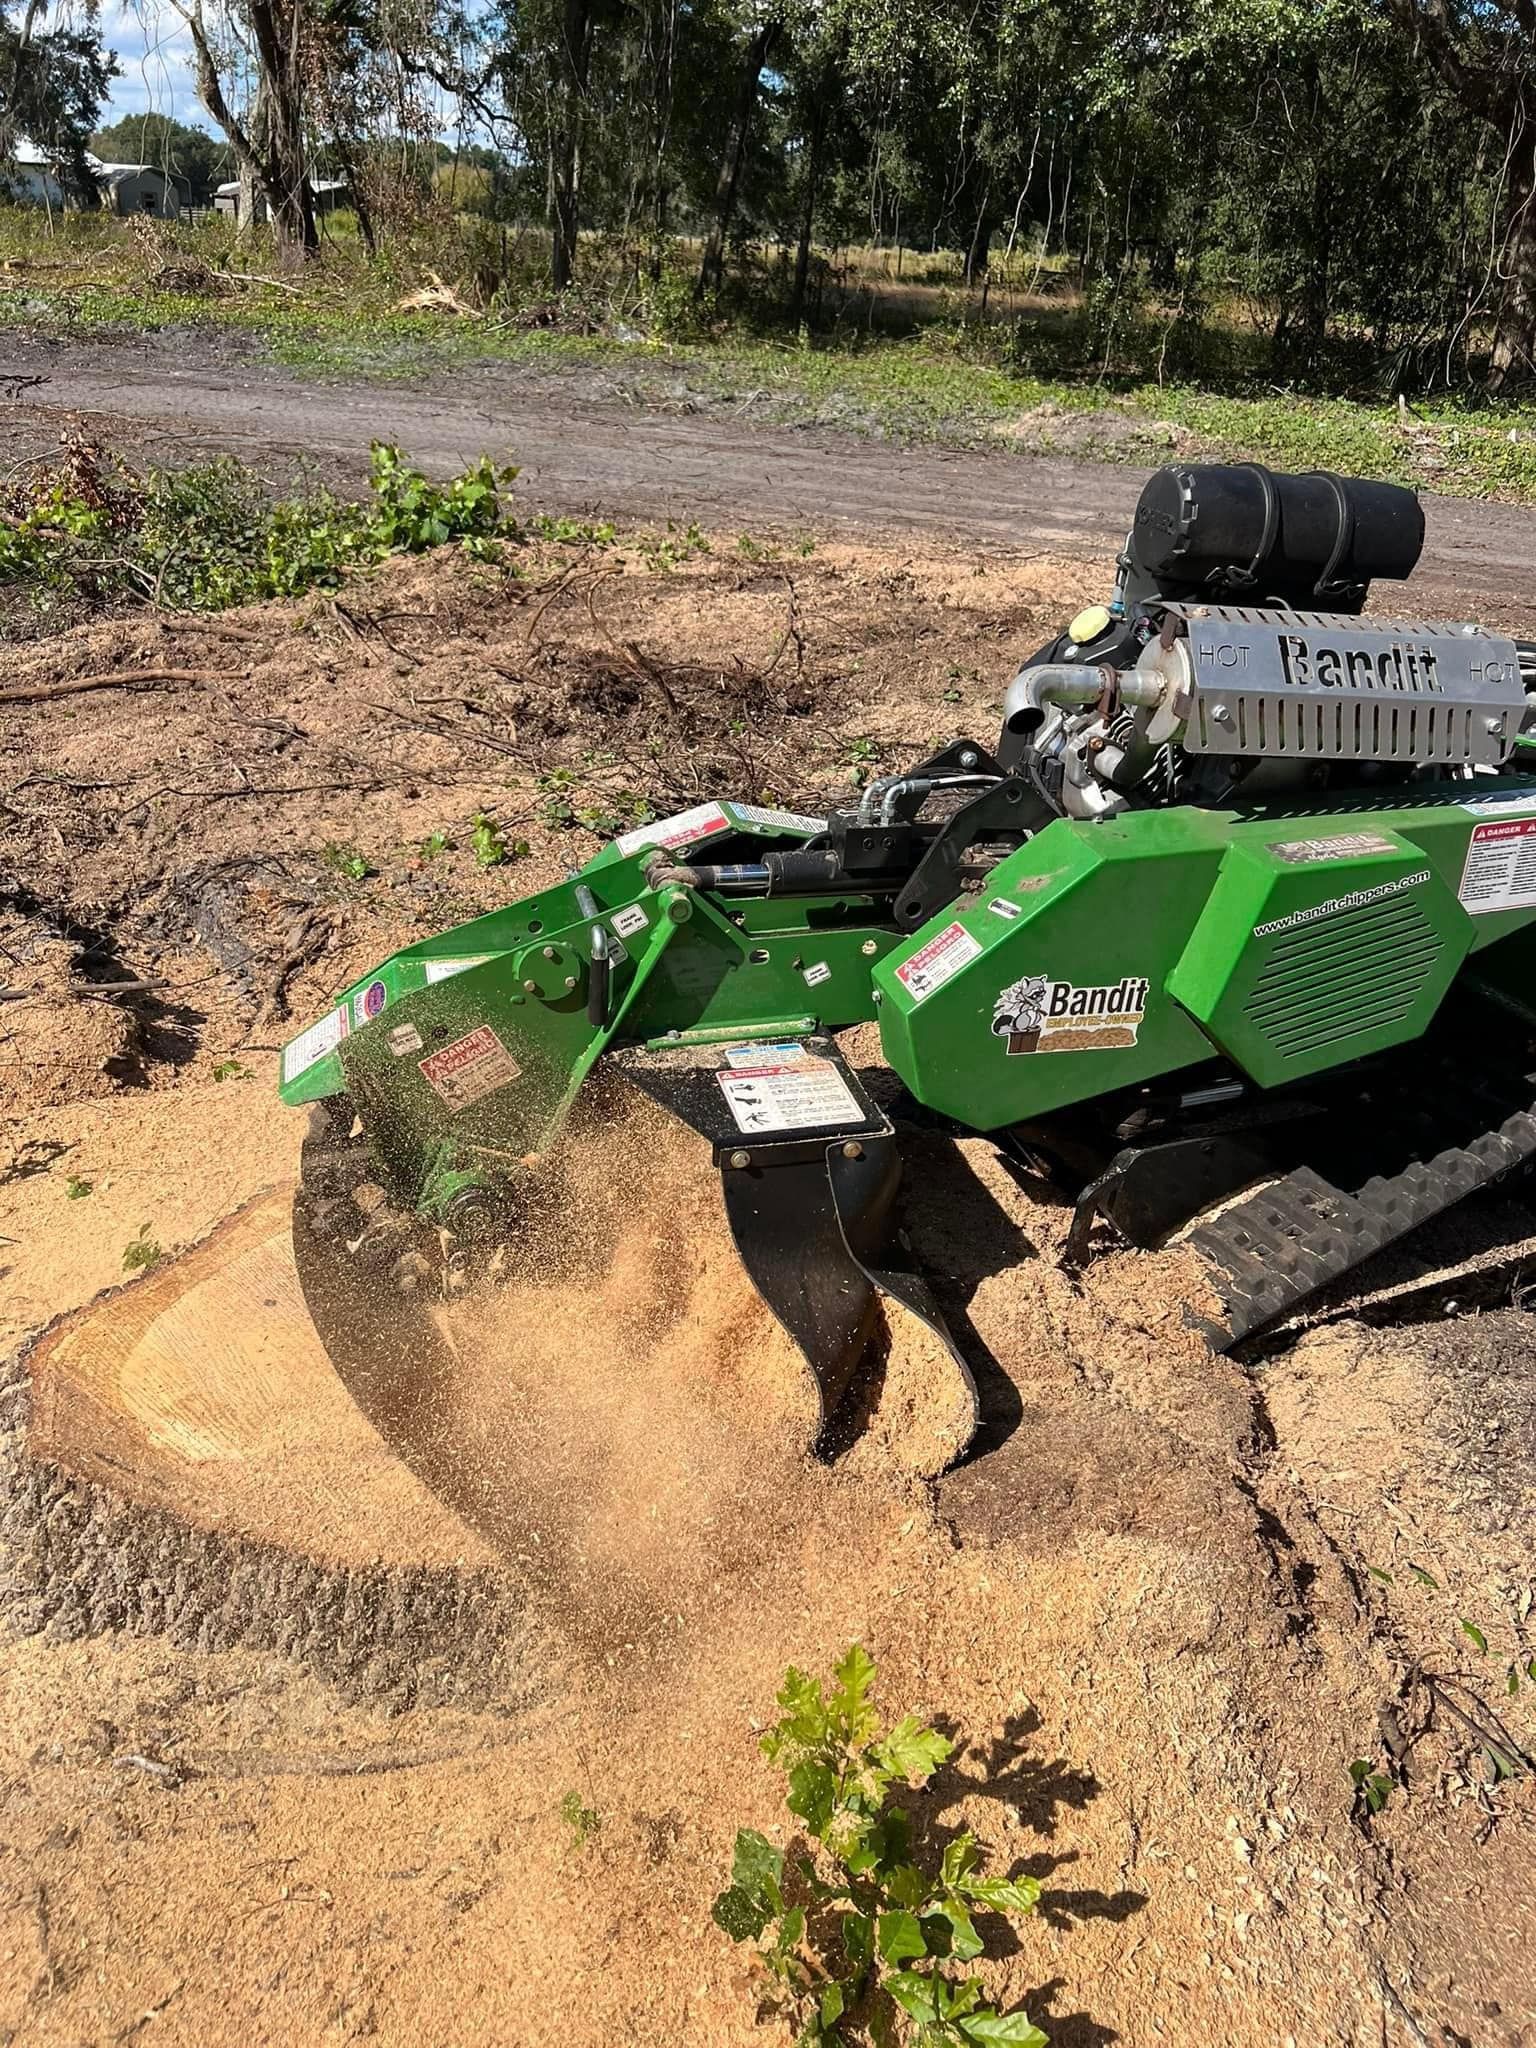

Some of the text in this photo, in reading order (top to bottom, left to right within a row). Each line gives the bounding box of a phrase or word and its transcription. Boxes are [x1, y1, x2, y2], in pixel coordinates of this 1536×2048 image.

[1199, 643, 1250, 667] HOT
[1278, 635, 1444, 694] Bandit
[1469, 660, 1515, 684] HOT
[1487, 825, 1522, 837] DANGER
[1254, 870, 1430, 937] www.banditchippers.com
[913, 926, 955, 962] DANGER
[1049, 979, 1147, 1016] Bandit
[439, 1029, 487, 1061] DANGER
